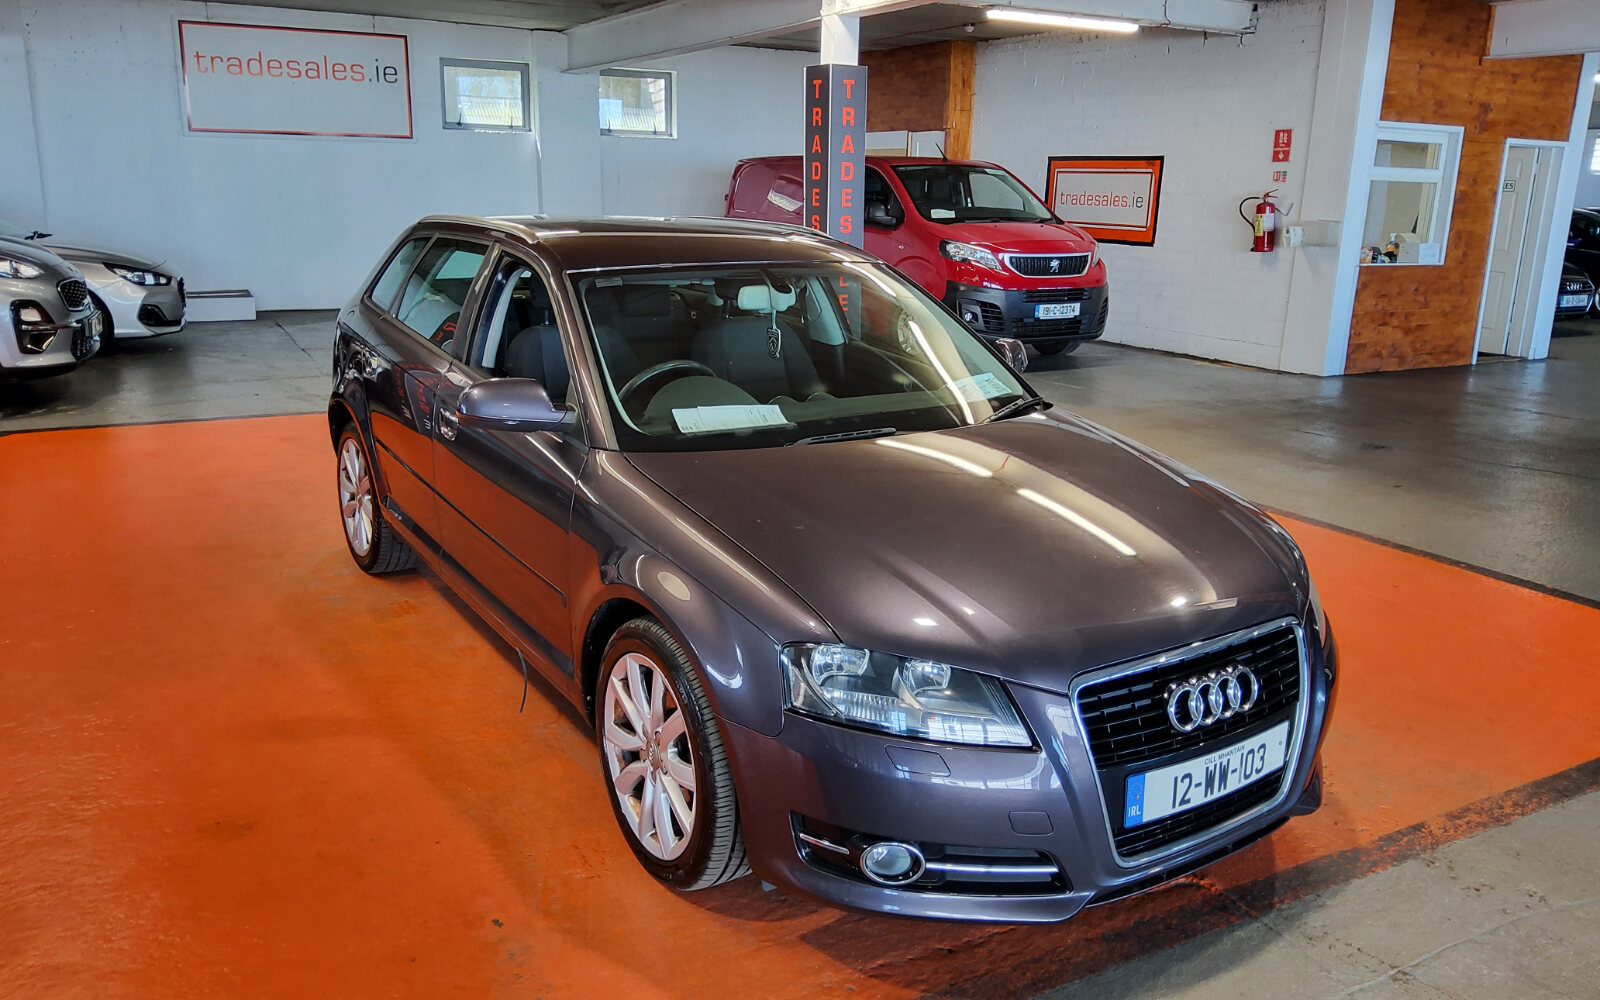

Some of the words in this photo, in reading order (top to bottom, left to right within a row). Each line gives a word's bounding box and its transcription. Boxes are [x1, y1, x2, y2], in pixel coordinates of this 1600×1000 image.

[194, 51, 398, 84] tradesales.ie
[1060, 190, 1144, 209] tradesales.ie
[1043, 305, 1076, 316] 191-C-12374
[1204, 755, 1217, 765] CILL
[1171, 742, 1267, 810] 12-WW-103
[1128, 805, 1142, 818] IRL
